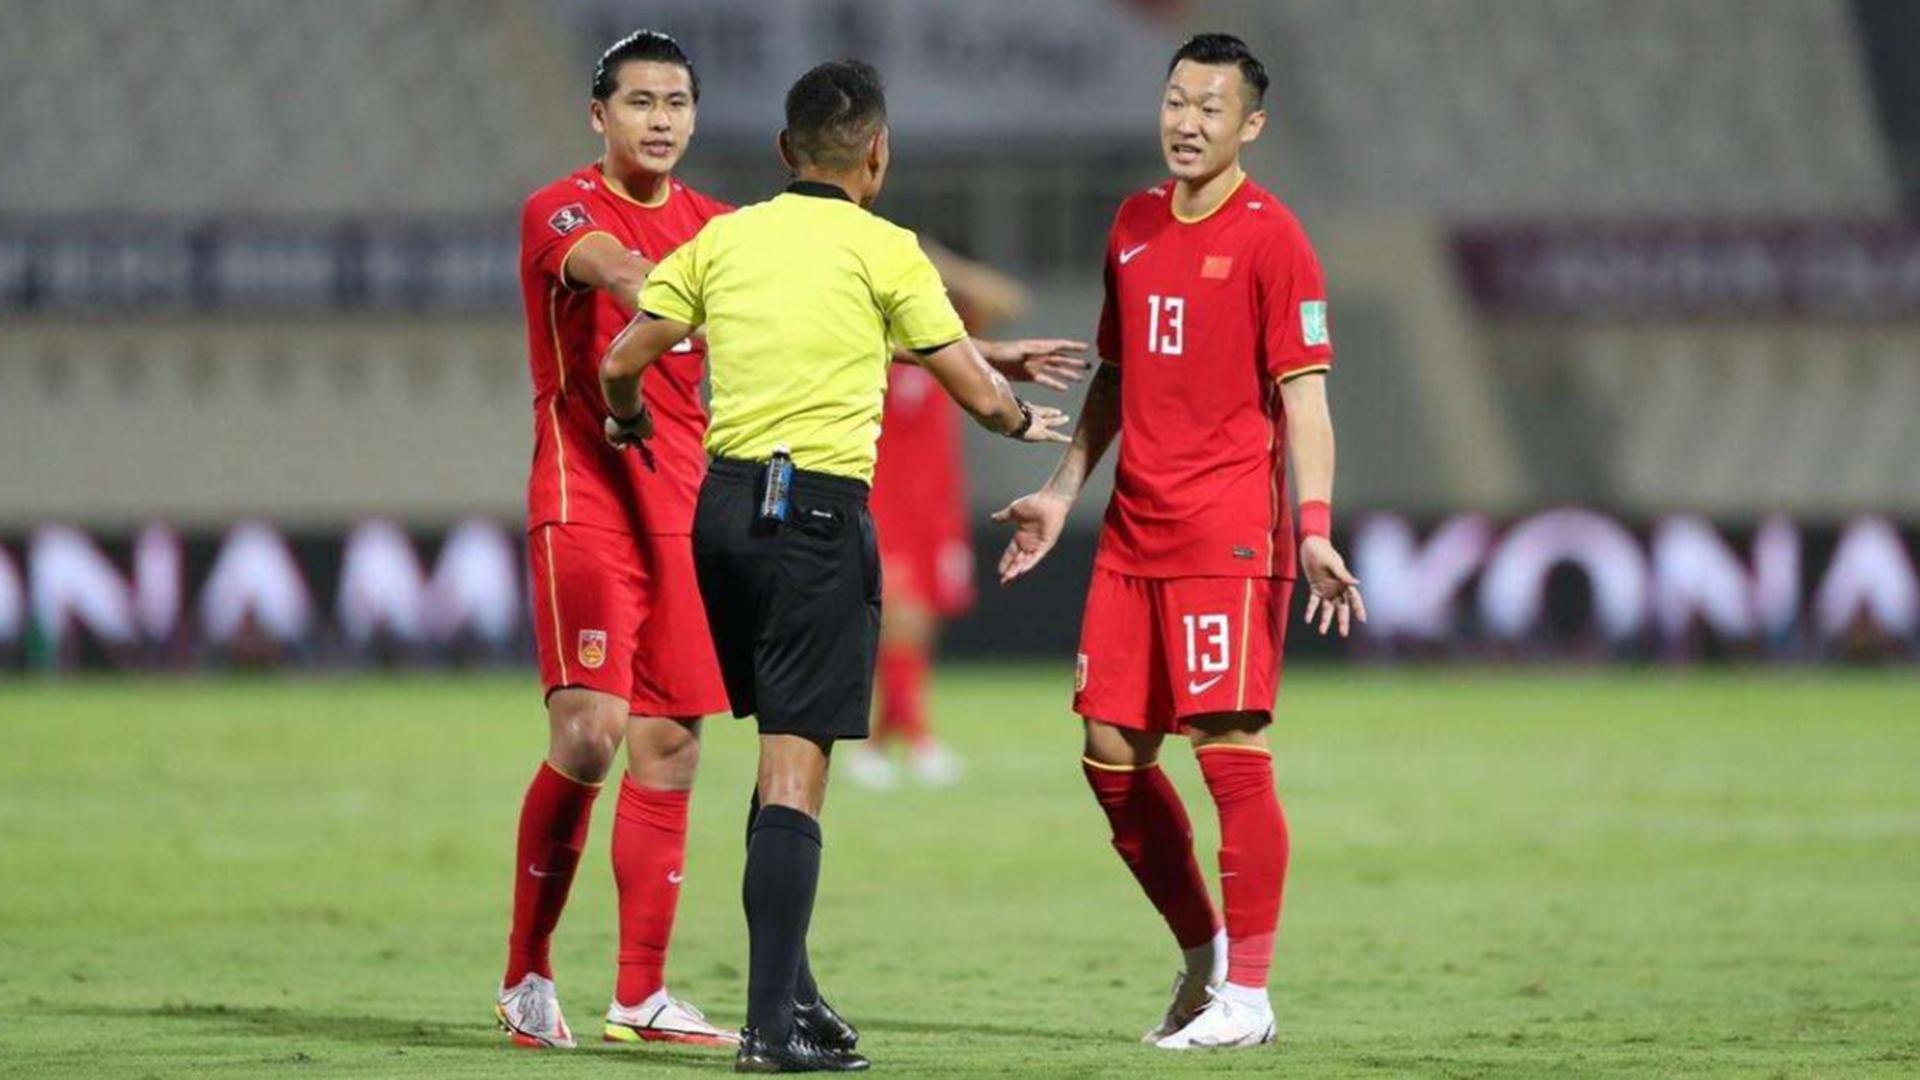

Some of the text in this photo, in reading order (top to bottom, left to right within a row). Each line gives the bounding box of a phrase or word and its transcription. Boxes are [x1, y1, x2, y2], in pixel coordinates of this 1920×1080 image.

[1147, 295, 1184, 355] 13
[0, 516, 522, 644] NAM
[1182, 613, 1230, 672] 13
